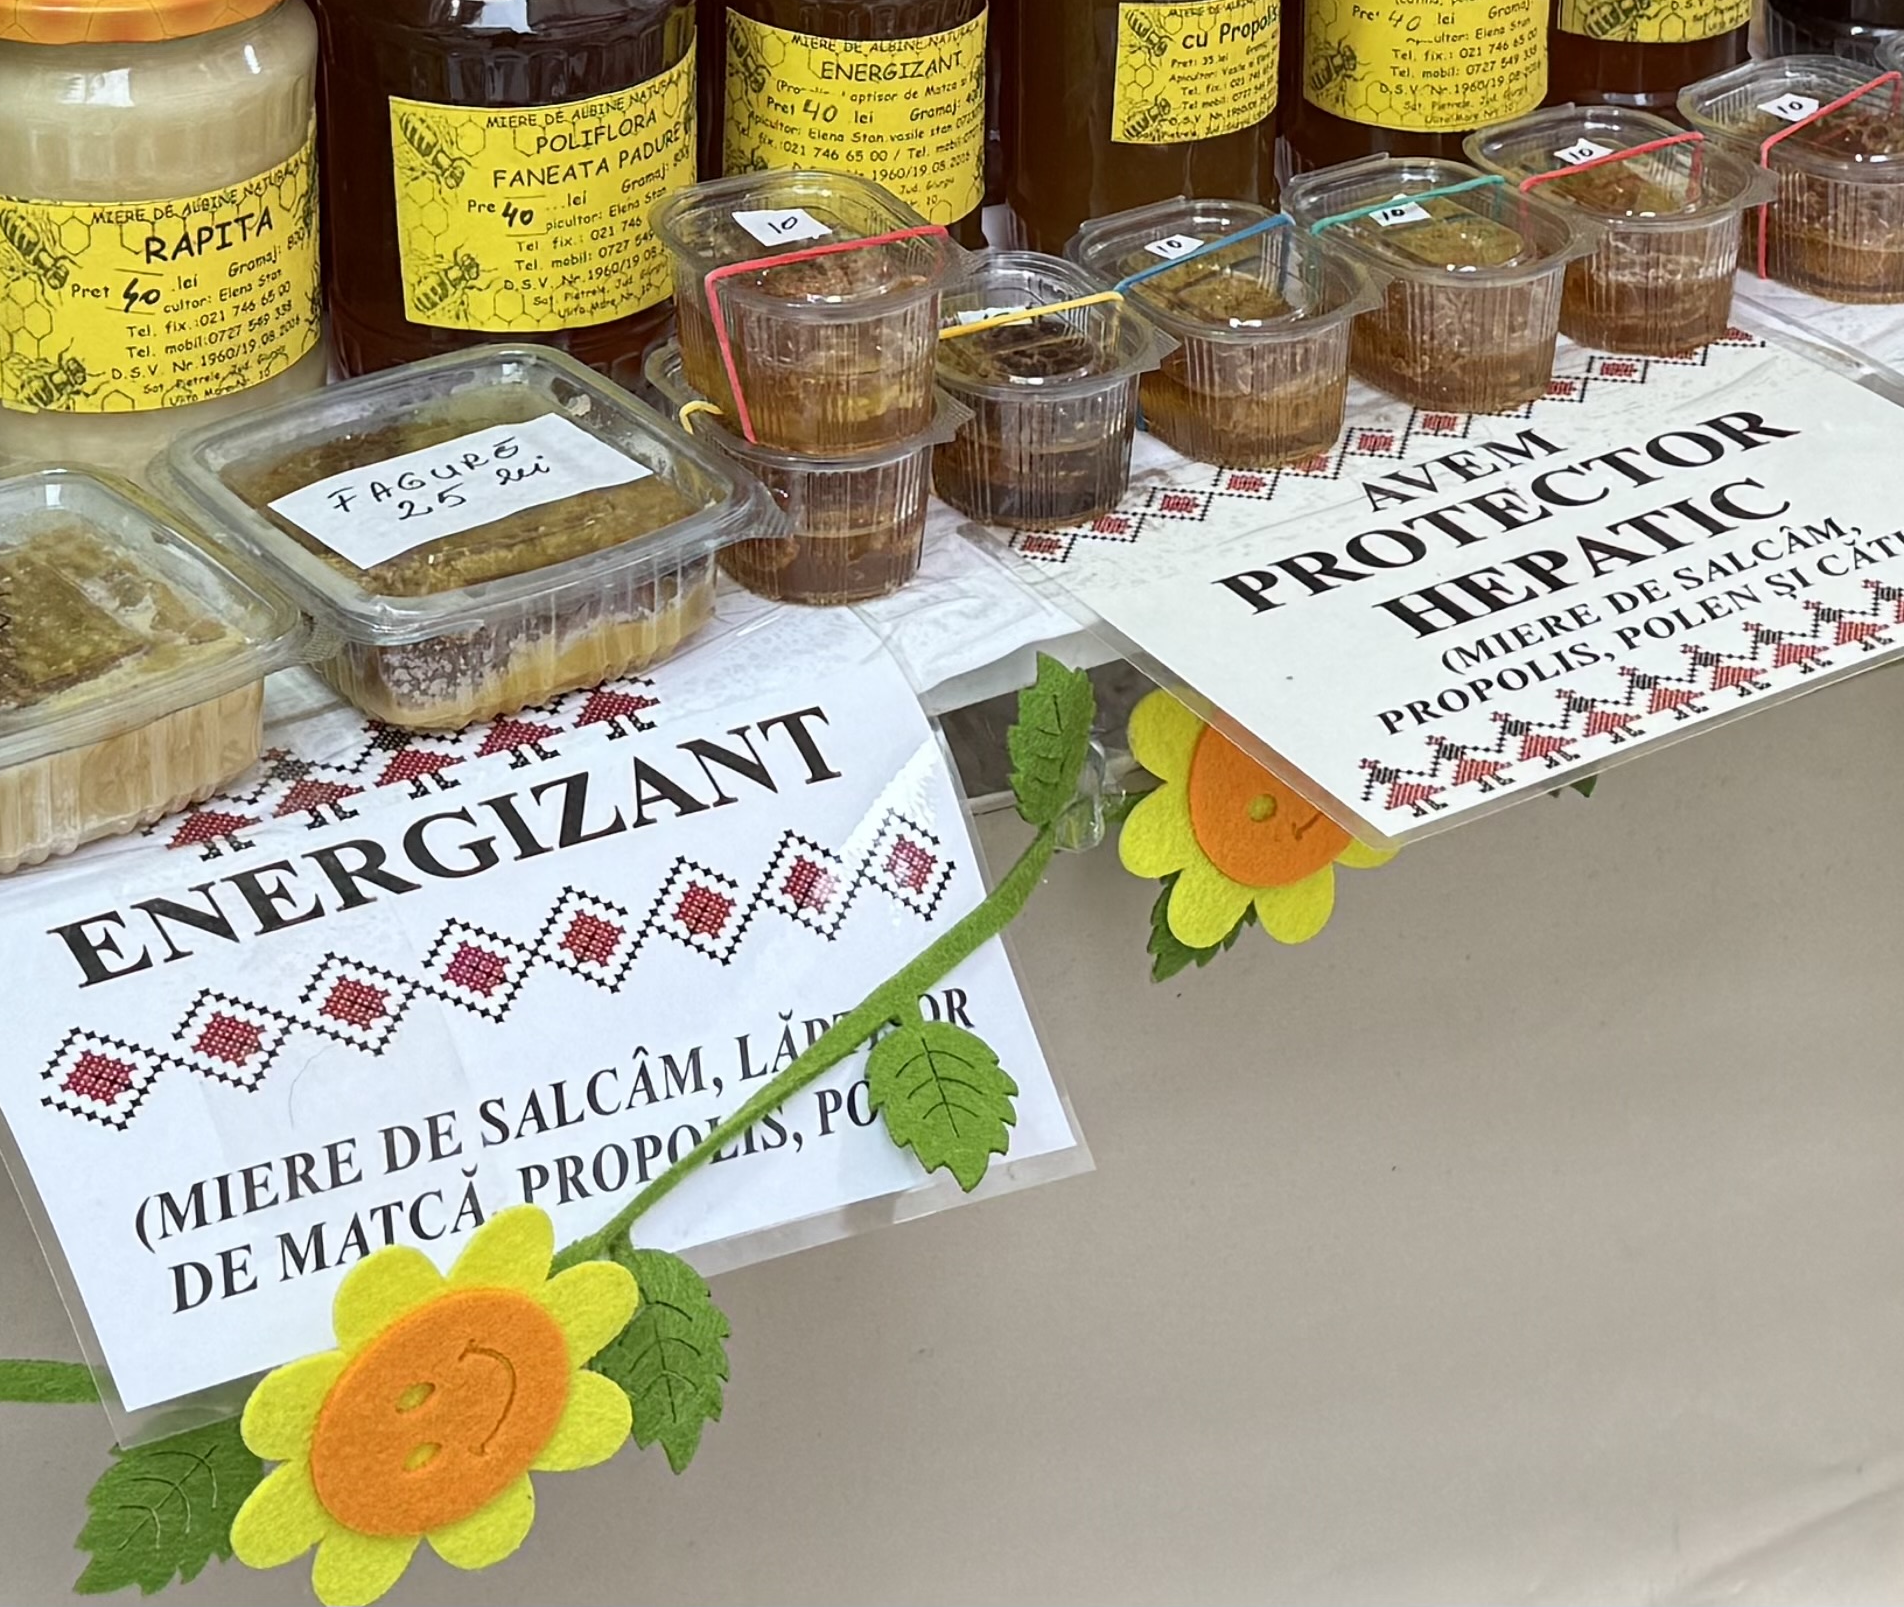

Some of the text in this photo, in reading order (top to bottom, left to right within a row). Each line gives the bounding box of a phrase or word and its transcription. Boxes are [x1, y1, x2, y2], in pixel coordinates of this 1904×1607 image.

[821, 50, 963, 82] ENERGIZANT
[1182, 32, 1208, 50] cu
[493, 123, 681, 189] FANEATA PADURE
[537, 108, 658, 154] POLIFLORA
[145, 207, 274, 264] RAPITA
[767, 216, 798, 235] 10
[327, 436, 521, 513] FAGURE
[396, 483, 468, 522] 25
[1358, 427, 1568, 513] AVEM
[1213, 410, 1803, 617] PROTECTOR
[1371, 477, 1792, 640] HEPATIC
[1441, 516, 1862, 676] (MIERE DE SALCÂM,
[1376, 637, 1616, 737] PROPOLIS,
[1614, 583, 1764, 652] POLEN
[44, 704, 844, 989] ENERGIZANT
[133, 1137, 363, 1253] (MIERE
[378, 1109, 464, 1176] DE
[479, 1044, 724, 1148] SALCÂM,
[167, 1243, 259, 1315] DE
